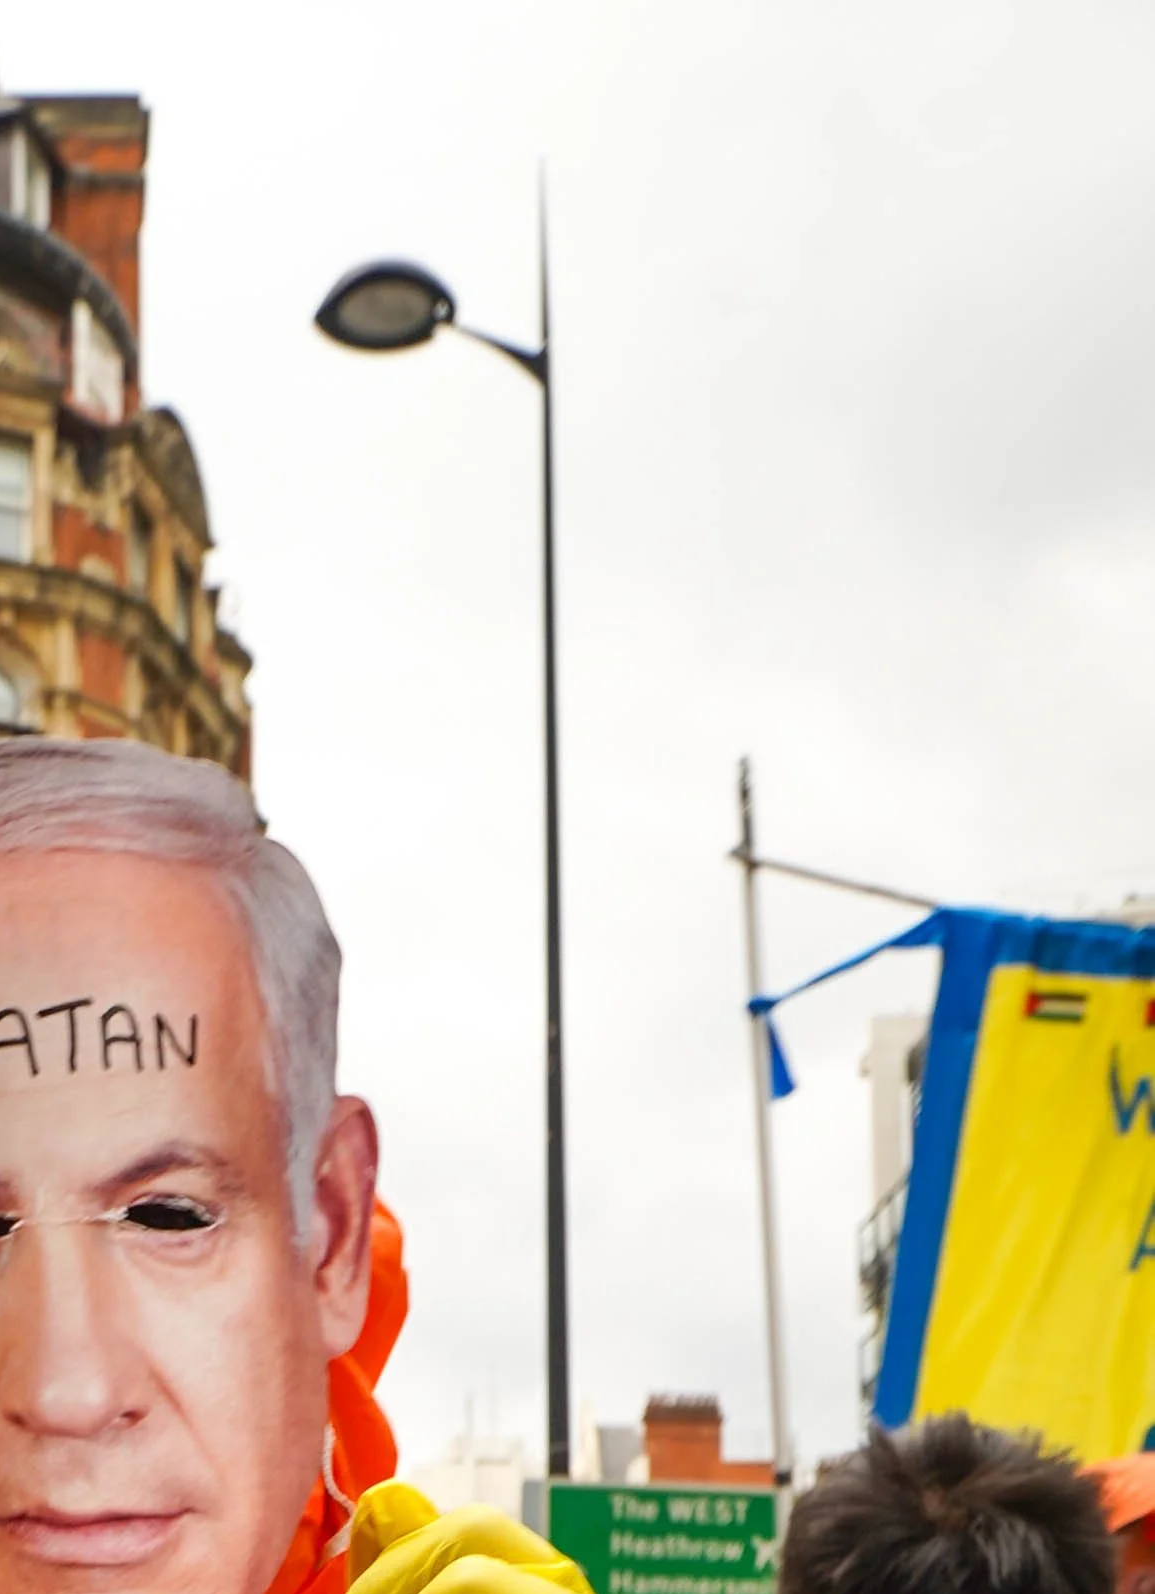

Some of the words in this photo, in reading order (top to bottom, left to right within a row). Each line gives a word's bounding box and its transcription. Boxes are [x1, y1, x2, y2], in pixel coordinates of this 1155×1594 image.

[611, 1494, 658, 1522] The
[668, 1498, 747, 1525] WEST
[610, 1531, 743, 1561] Heathrow
